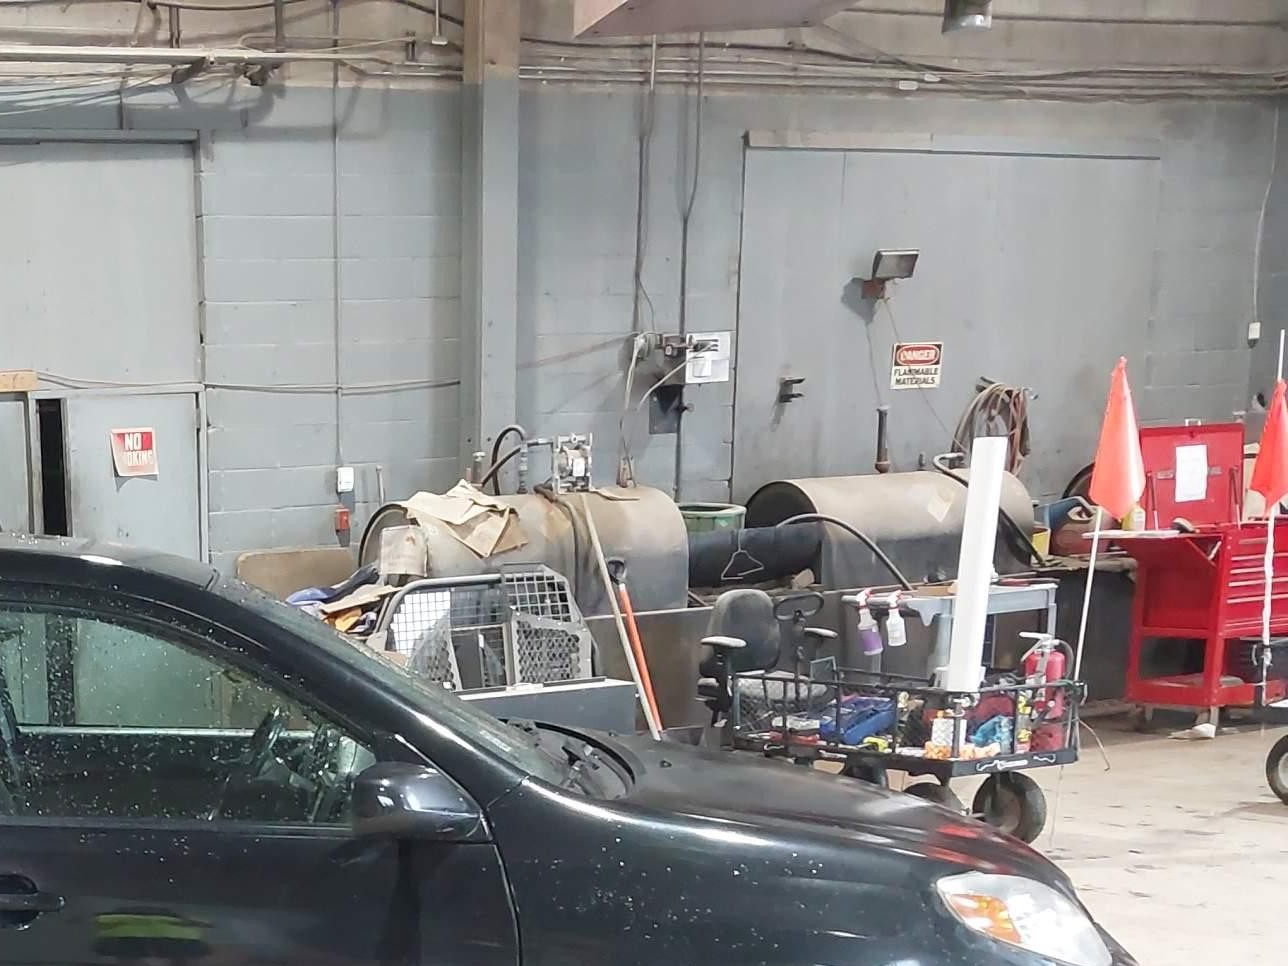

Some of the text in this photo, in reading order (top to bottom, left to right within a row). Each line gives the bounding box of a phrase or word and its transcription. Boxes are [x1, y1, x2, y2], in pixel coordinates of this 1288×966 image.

[900, 349, 936, 361] DANGER
[894, 367, 938, 377] FLAMMABLE
[895, 376, 936, 385] MATERIALS
[124, 432, 142, 451] NO
